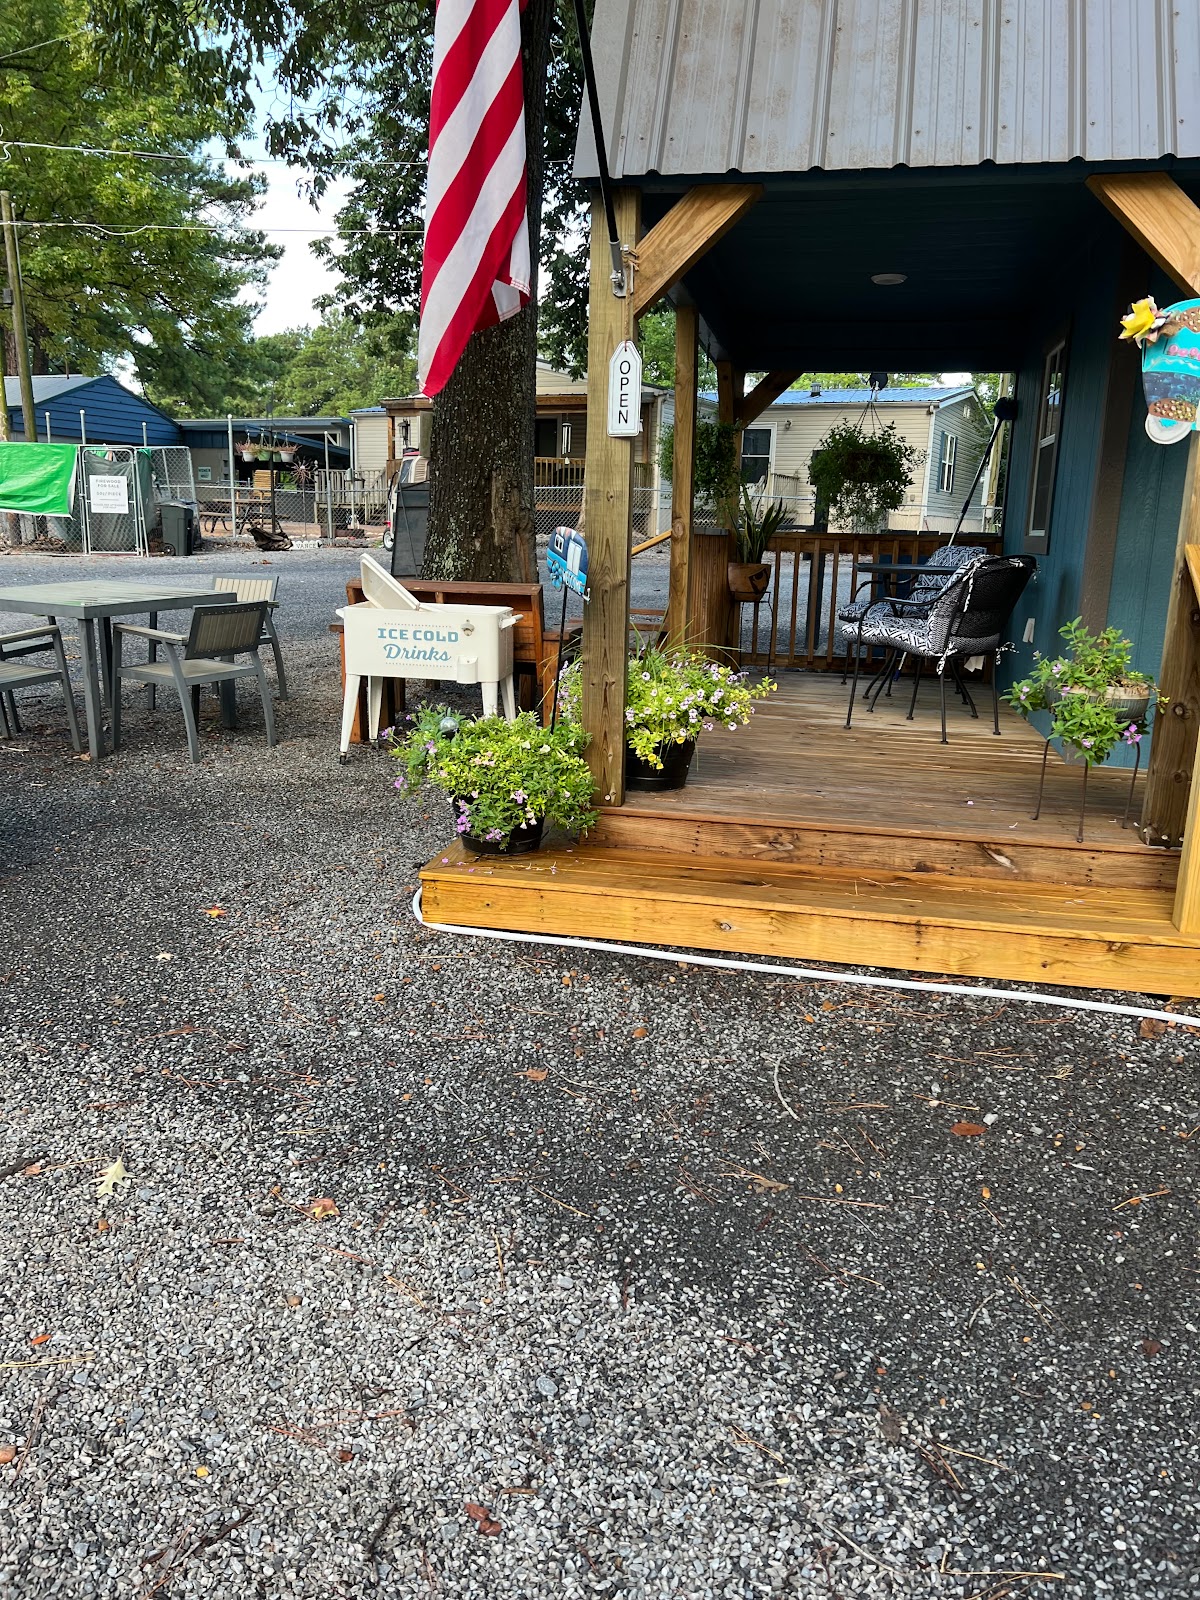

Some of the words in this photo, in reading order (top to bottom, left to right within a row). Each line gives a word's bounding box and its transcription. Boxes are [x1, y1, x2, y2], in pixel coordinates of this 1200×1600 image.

[618, 360, 631, 424] OPEN
[377, 627, 409, 640] ICE
[412, 629, 459, 642] COLD
[383, 643, 452, 662] Drinks
